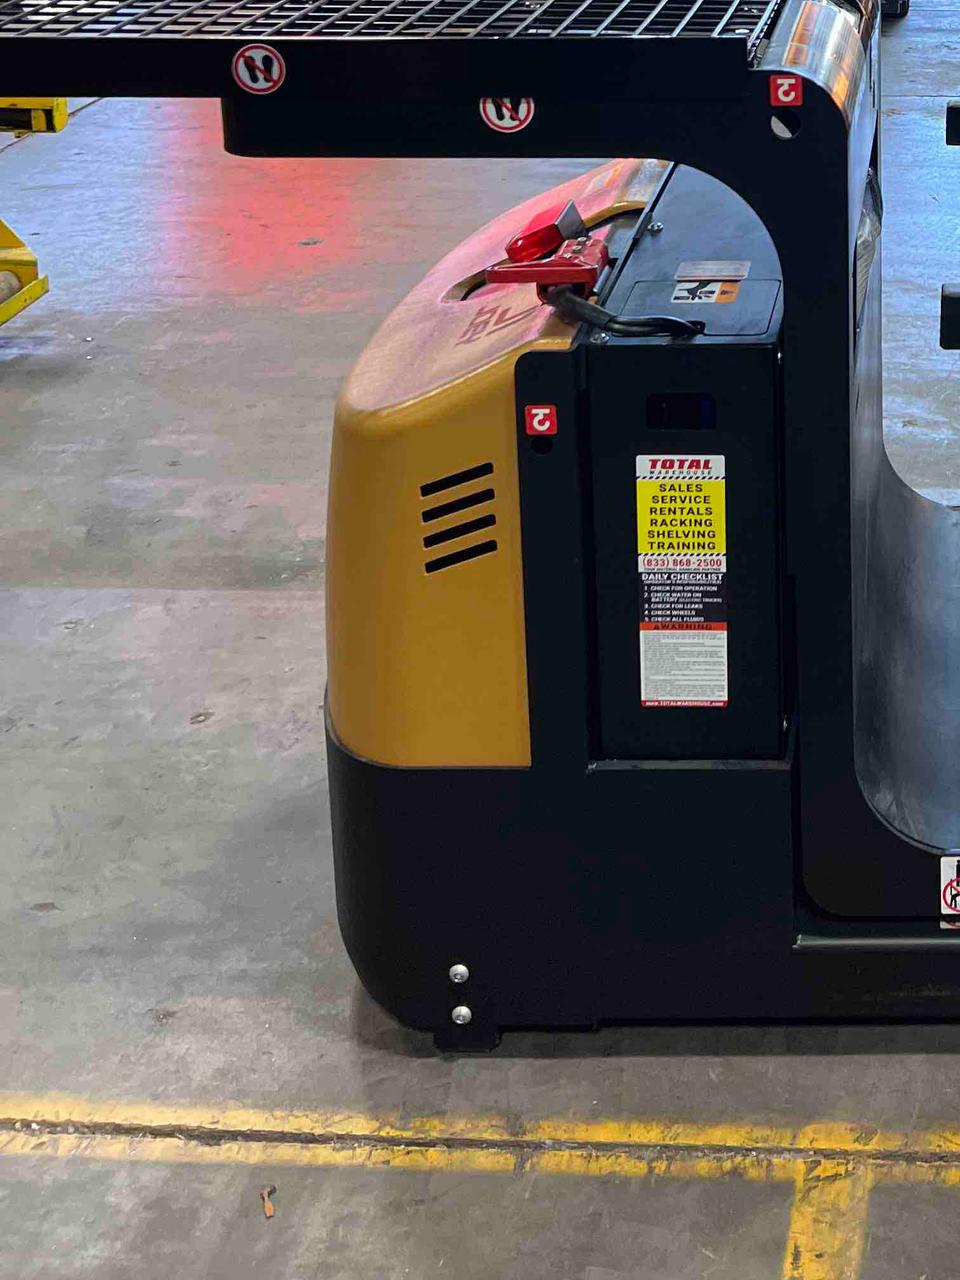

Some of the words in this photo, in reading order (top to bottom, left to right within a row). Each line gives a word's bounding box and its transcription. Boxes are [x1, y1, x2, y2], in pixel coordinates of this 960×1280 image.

[649, 458, 712, 470] TOTAL
[659, 483, 703, 493] SALES
[652, 495, 711, 504] SERVICE
[650, 507, 713, 516] RENTALS
[650, 518, 713, 527] RACKING
[648, 530, 716, 539] SHELVING
[648, 541, 716, 550] TRAINING
[643, 558, 669, 568] (833)
[672, 558, 722, 568] 868-2500
[659, 623, 713, 631] WARNING
